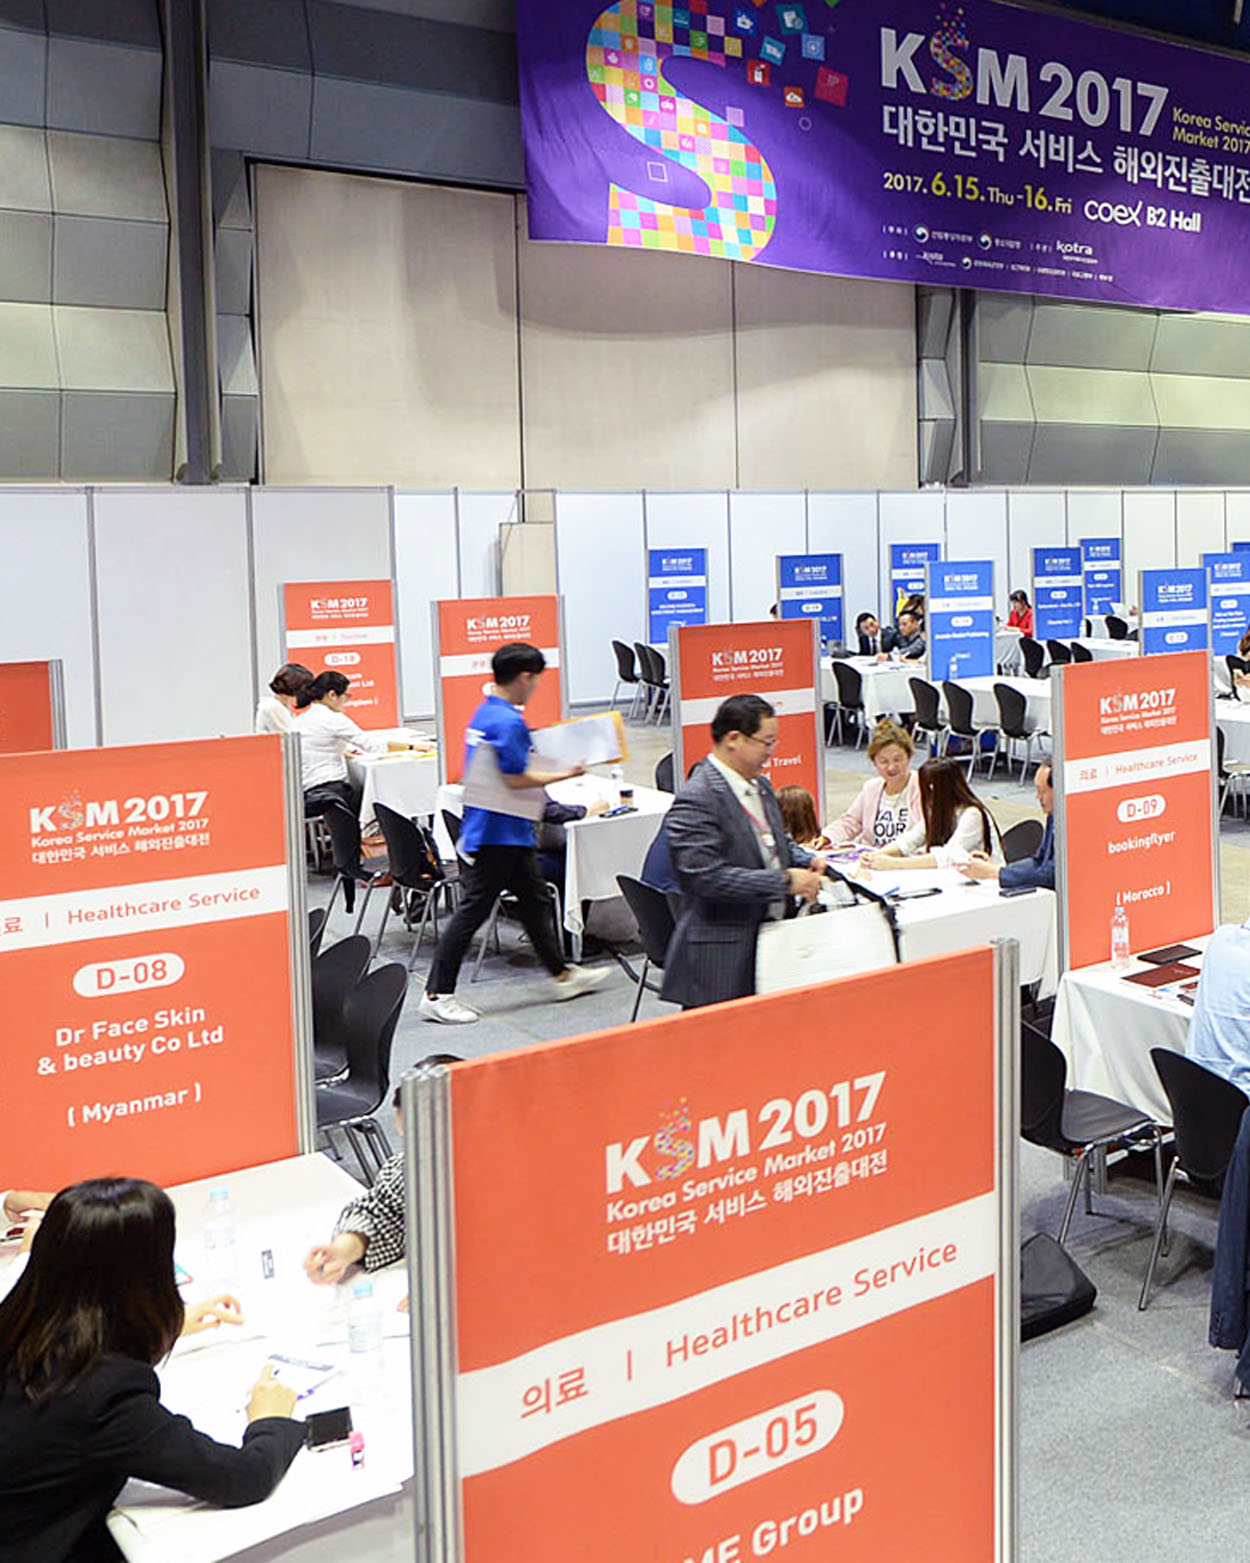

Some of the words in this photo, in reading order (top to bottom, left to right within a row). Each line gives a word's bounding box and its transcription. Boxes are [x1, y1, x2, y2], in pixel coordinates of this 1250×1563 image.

[880, 22, 1030, 113] KSM
[1038, 61, 1169, 137] 2017
[1172, 107, 1212, 128] Korea
[882, 104, 1010, 163] 대한민국
[1018, 129, 1104, 174] 서비스
[1172, 126, 1220, 149] Market
[1146, 205, 1167, 228] B2
[1169, 208, 1202, 233] Hall
[340, 597, 369, 608] 2017
[499, 615, 531, 627] 2017
[711, 650, 748, 666] KSM
[749, 648, 783, 664] 2017
[1100, 692, 1138, 715] KSM
[1139, 688, 1176, 710] 2017
[773, 756, 802, 768] Travel
[29, 797, 120, 833] KSM
[124, 790, 209, 824] 2017
[1126, 798, 1158, 818] D-09
[31, 834, 73, 848] Korea
[76, 828, 124, 844] Service
[128, 822, 175, 838] Market
[178, 818, 209, 832] 2017
[1107, 830, 1176, 854] bookingflyer
[32, 846, 86, 864] 대한민국
[90, 842, 131, 858] 서비스
[67, 898, 182, 925] Healthcare
[188, 886, 261, 909] Service
[1122, 885, 1164, 905] Morocco
[96, 959, 168, 990] D-08
[55, 1027, 85, 1047] Dr
[92, 1017, 149, 1041] Face
[154, 1006, 206, 1029] Skin
[36, 1056, 57, 1076] &
[64, 1042, 146, 1072] beauty
[151, 1036, 182, 1055] Co
[187, 1025, 224, 1049] Ltd
[82, 1087, 189, 1124] Myanmar
[605, 1106, 750, 1195] KSM
[758, 1070, 887, 1151] 2017
[606, 1190, 676, 1223] Korea
[682, 1166, 758, 1203] Service
[764, 1141, 836, 1178] Market
[841, 1122, 887, 1153] 2017
[606, 1209, 698, 1255] 대한민국
[703, 1187, 769, 1225] 서비스
[772, 1149, 888, 1203] 해외진출대전
[520, 1366, 589, 1420] 의료
[665, 1282, 843, 1368] Healthcare
[852, 1241, 959, 1299] Service
[707, 1402, 818, 1488] D-05
[751, 1487, 864, 1558] Group
